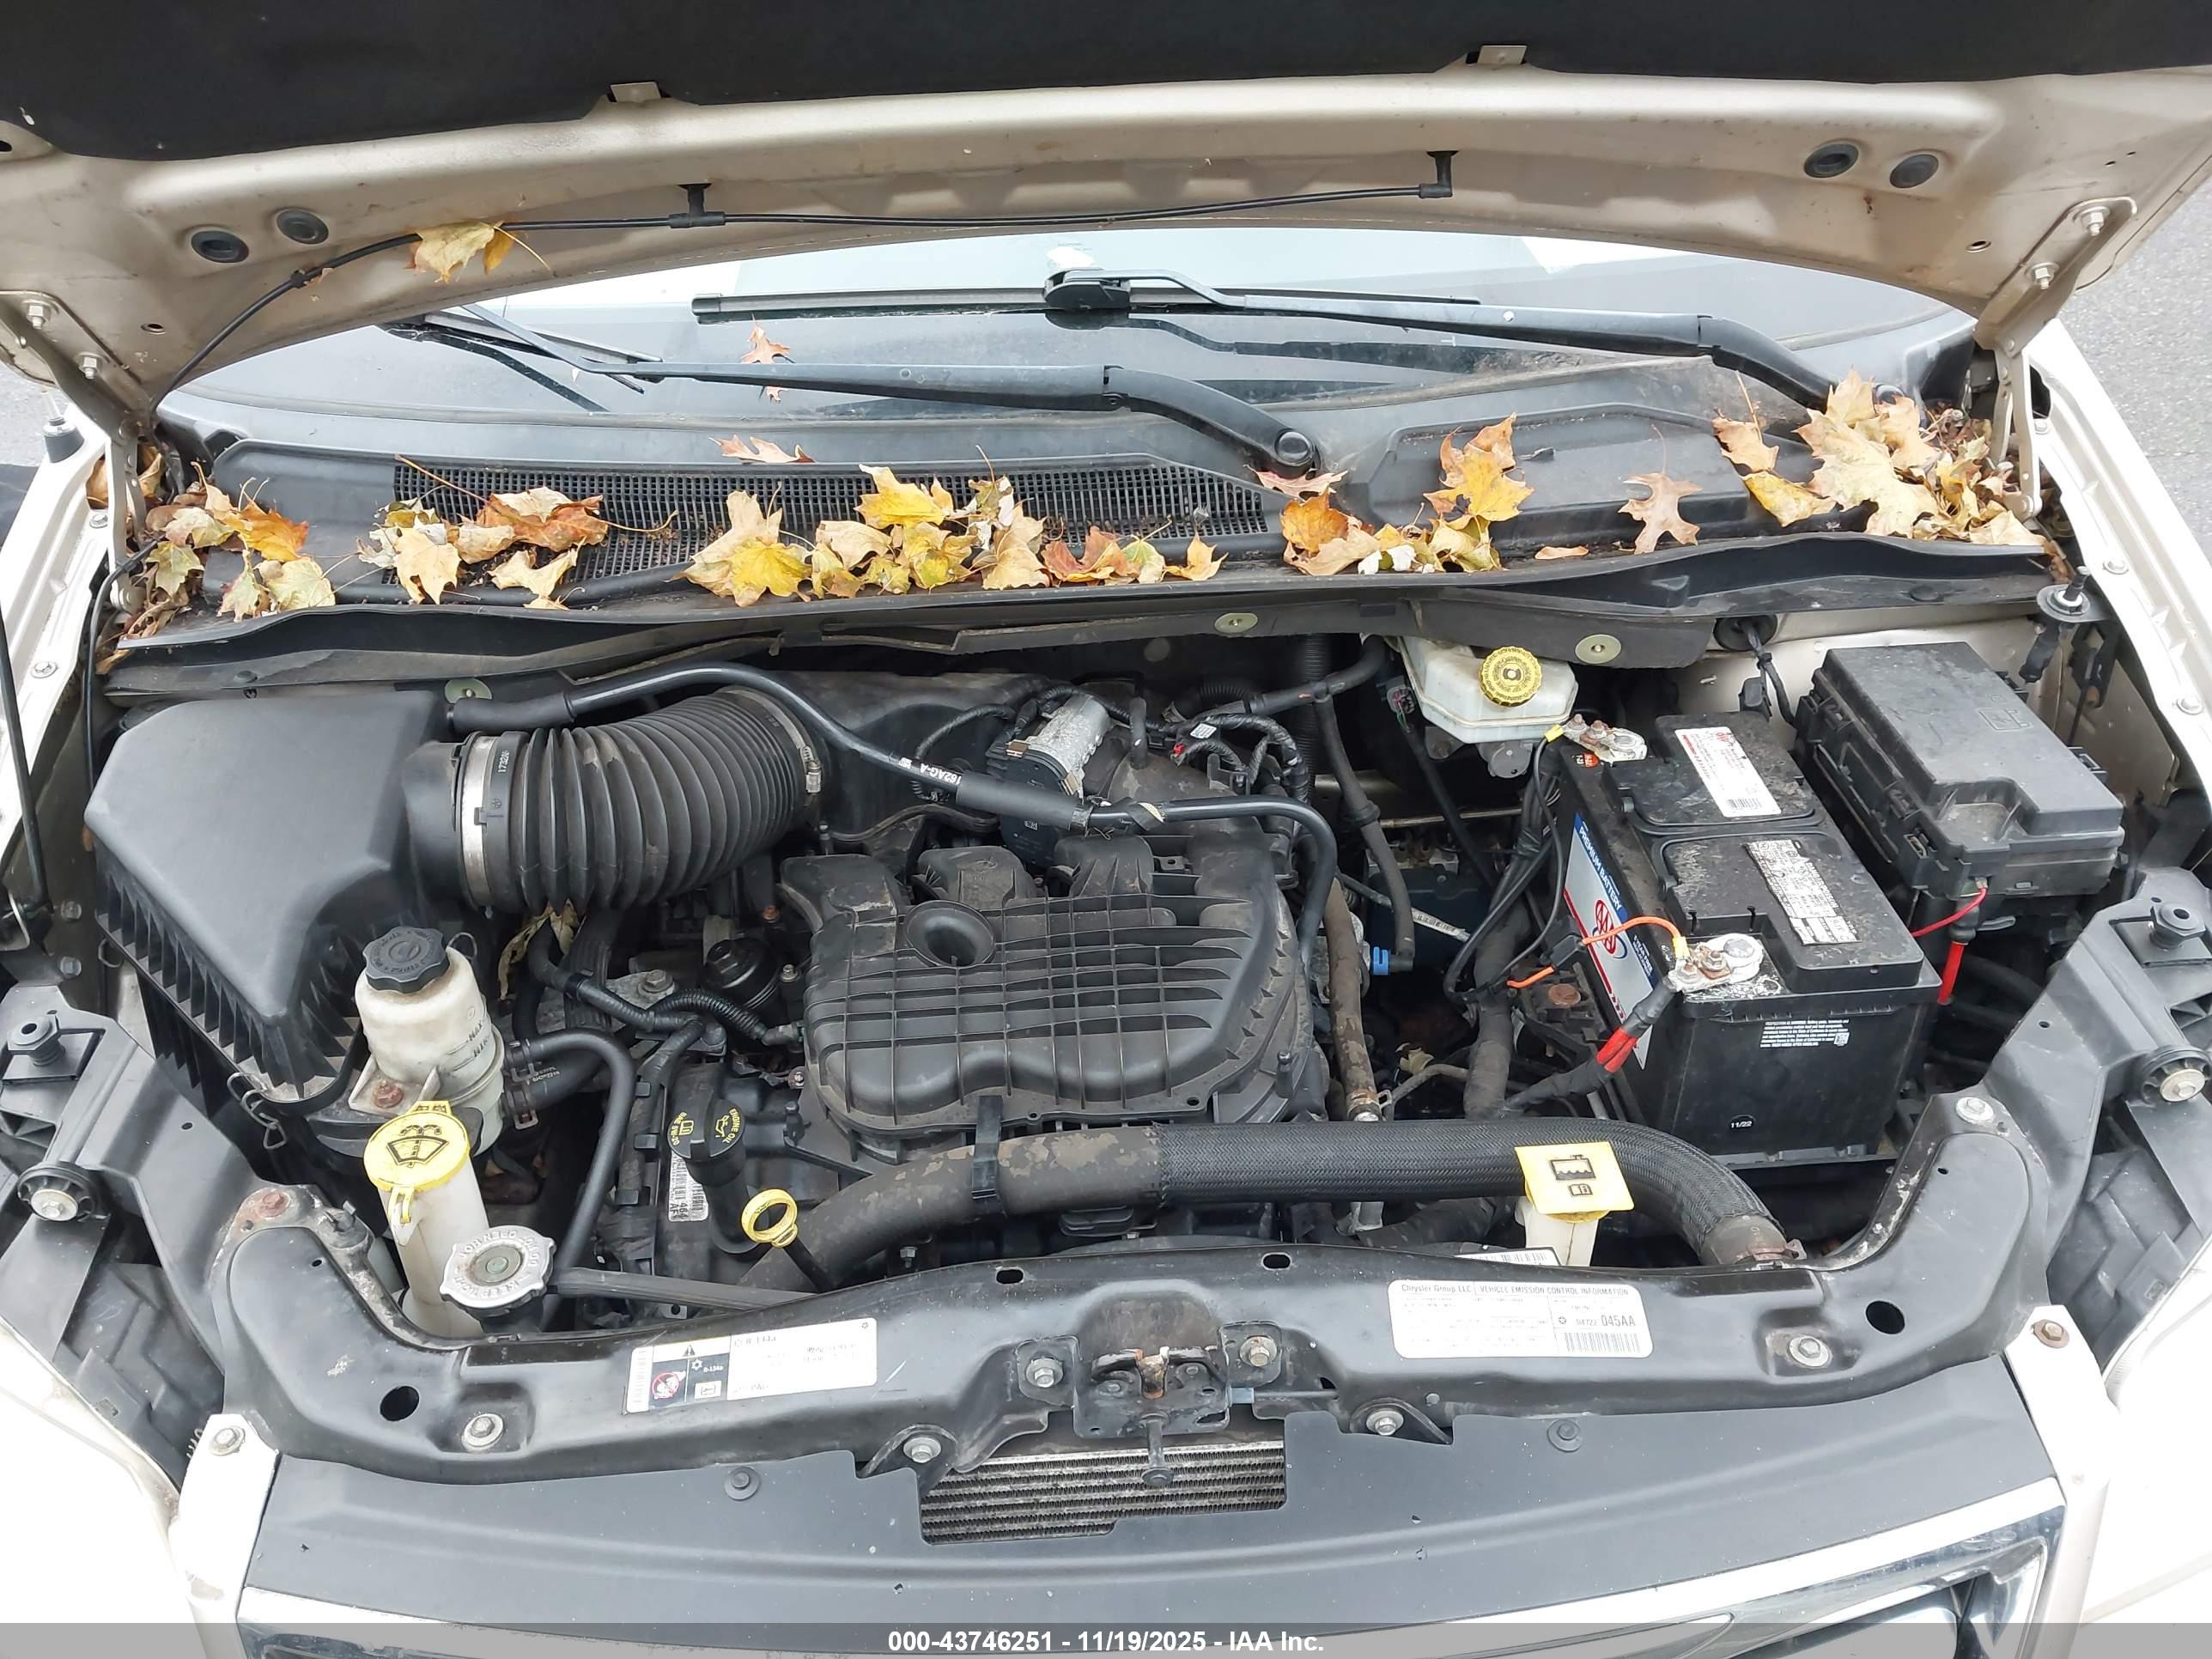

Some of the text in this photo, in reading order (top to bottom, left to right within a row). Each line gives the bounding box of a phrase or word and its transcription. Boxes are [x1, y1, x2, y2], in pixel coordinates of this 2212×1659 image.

[920, 763, 962, 785] 162AG-A
[1579, 827, 1622, 911] PREMIUM BATTERY
[722, 1108, 741, 1144] ENGINE OIL
[1730, 1121, 1753, 1129] 11/22
[1401, 1284, 1431, 1292] Chrysler
[1434, 1285, 1455, 1293] Group
[1547, 1286, 1578, 1295] CONTROL
[1581, 1287, 1628, 1296] INFORMATION
[1601, 1315, 1636, 1327] 045AA
